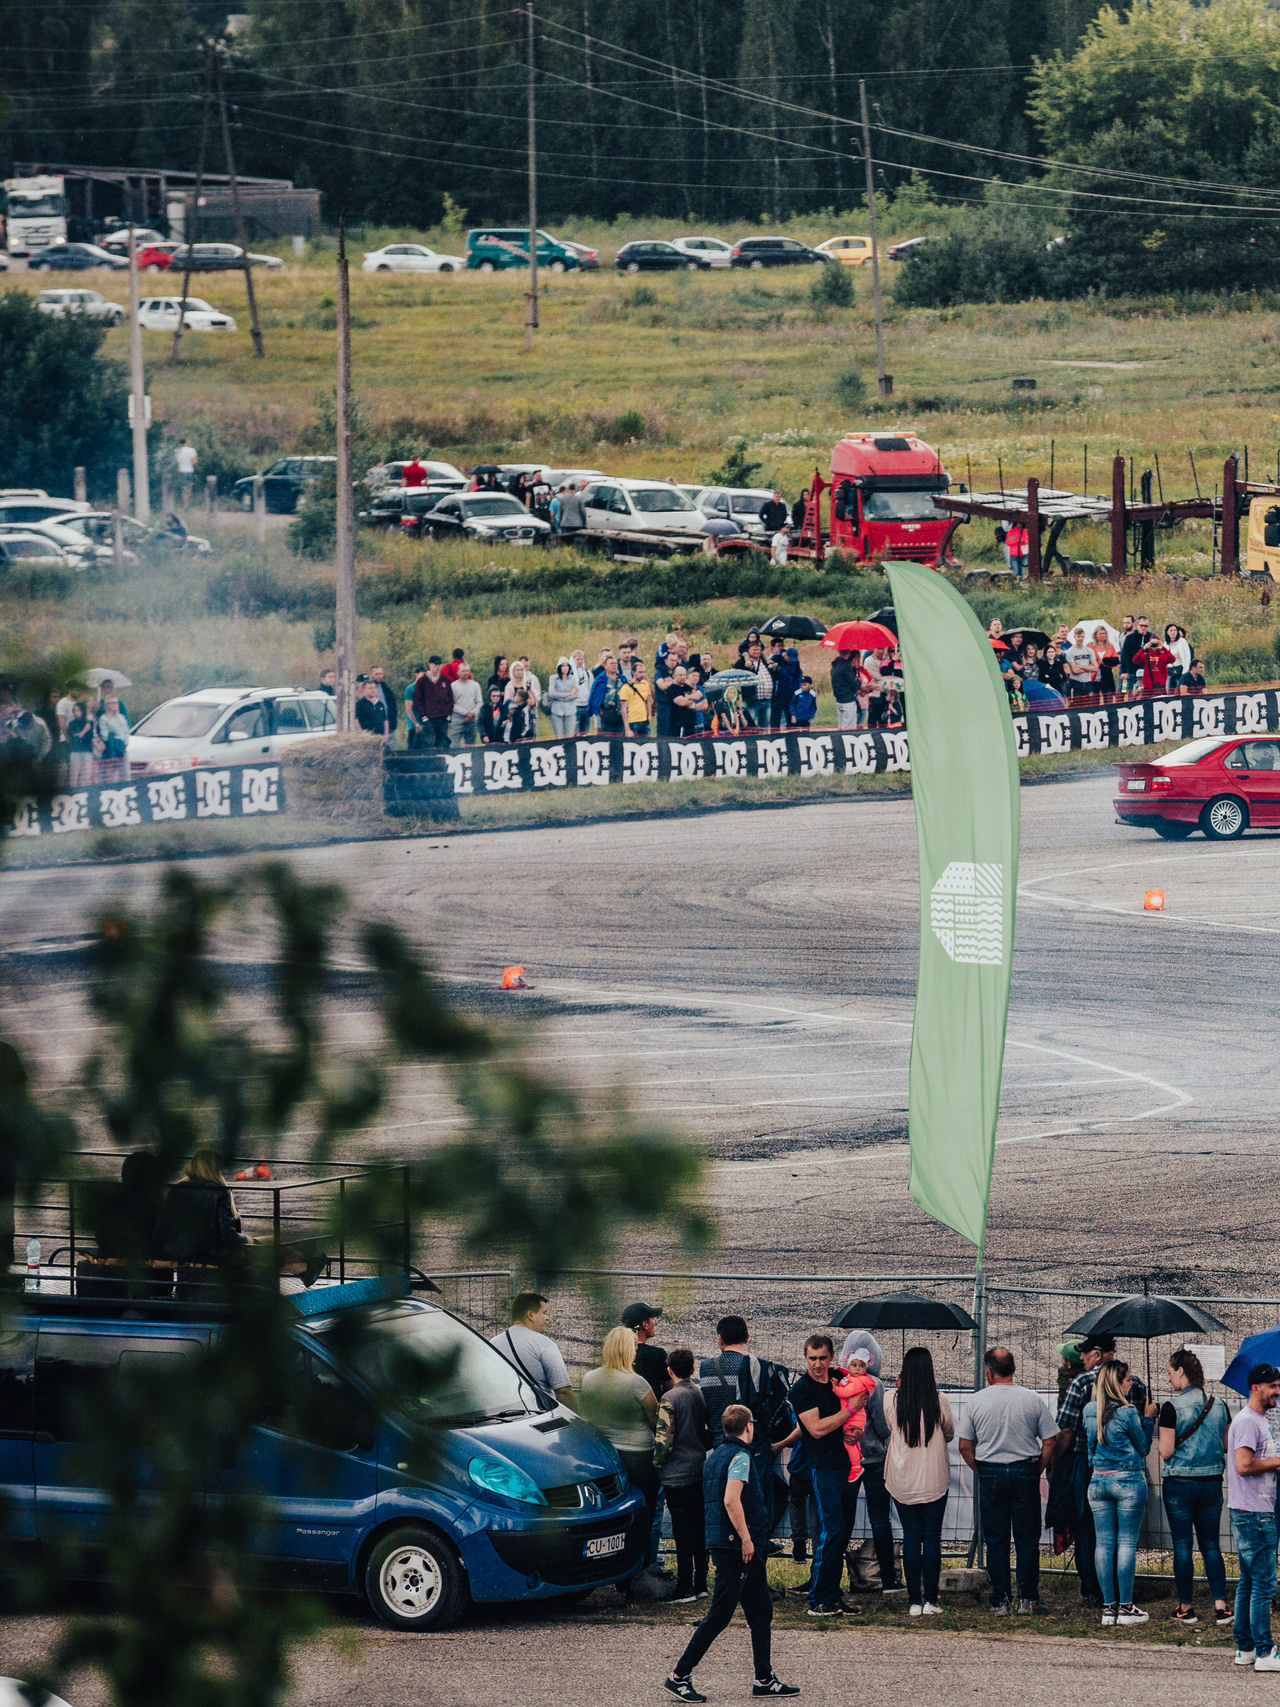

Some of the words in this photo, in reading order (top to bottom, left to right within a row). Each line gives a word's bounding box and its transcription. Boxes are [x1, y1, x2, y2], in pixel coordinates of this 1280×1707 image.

[1038, 714, 1071, 755] DC
[1078, 711, 1110, 749] DC
[1117, 704, 1145, 747] DC
[1153, 699, 1183, 742] DC
[1193, 696, 1226, 739] DC
[1236, 693, 1268, 733] DC
[484, 750, 523, 791] DC
[530, 745, 567, 787] DC
[576, 741, 610, 786] DC
[623, 742, 659, 784] DC
[669, 742, 704, 783] DC
[713, 741, 747, 779] DC
[756, 738, 789, 779] DC
[797, 735, 835, 778] DC
[842, 734, 877, 776] DC
